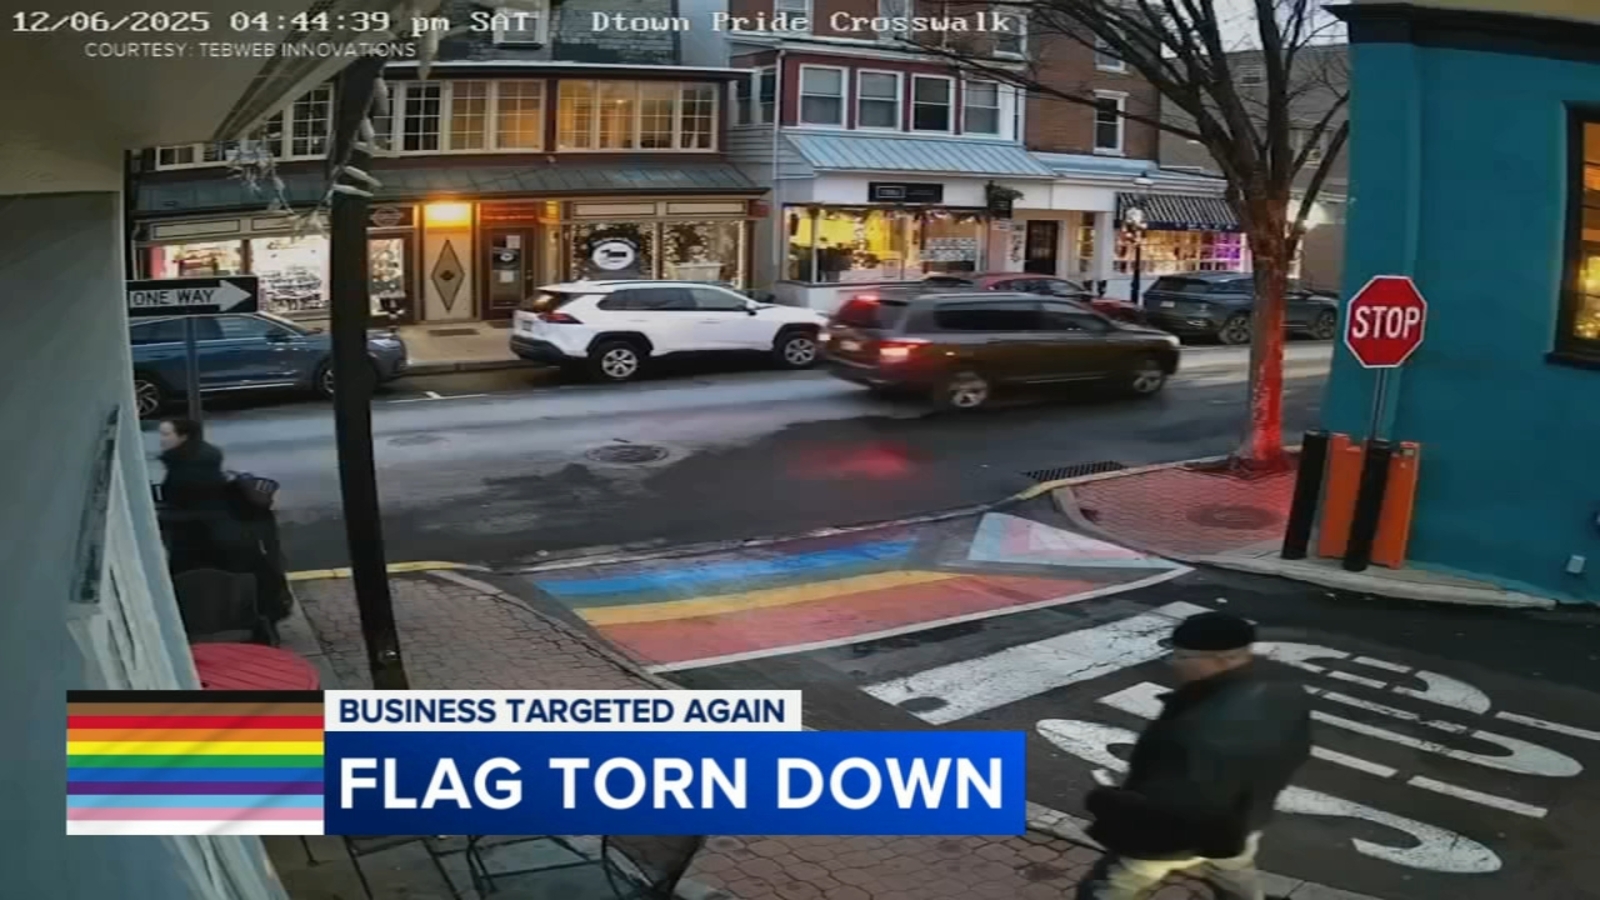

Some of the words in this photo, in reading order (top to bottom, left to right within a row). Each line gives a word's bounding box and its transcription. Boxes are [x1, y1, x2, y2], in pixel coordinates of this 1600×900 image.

[132, 290, 170, 306] ONE
[176, 289, 215, 304] WAY
[1351, 305, 1421, 339] STOP
